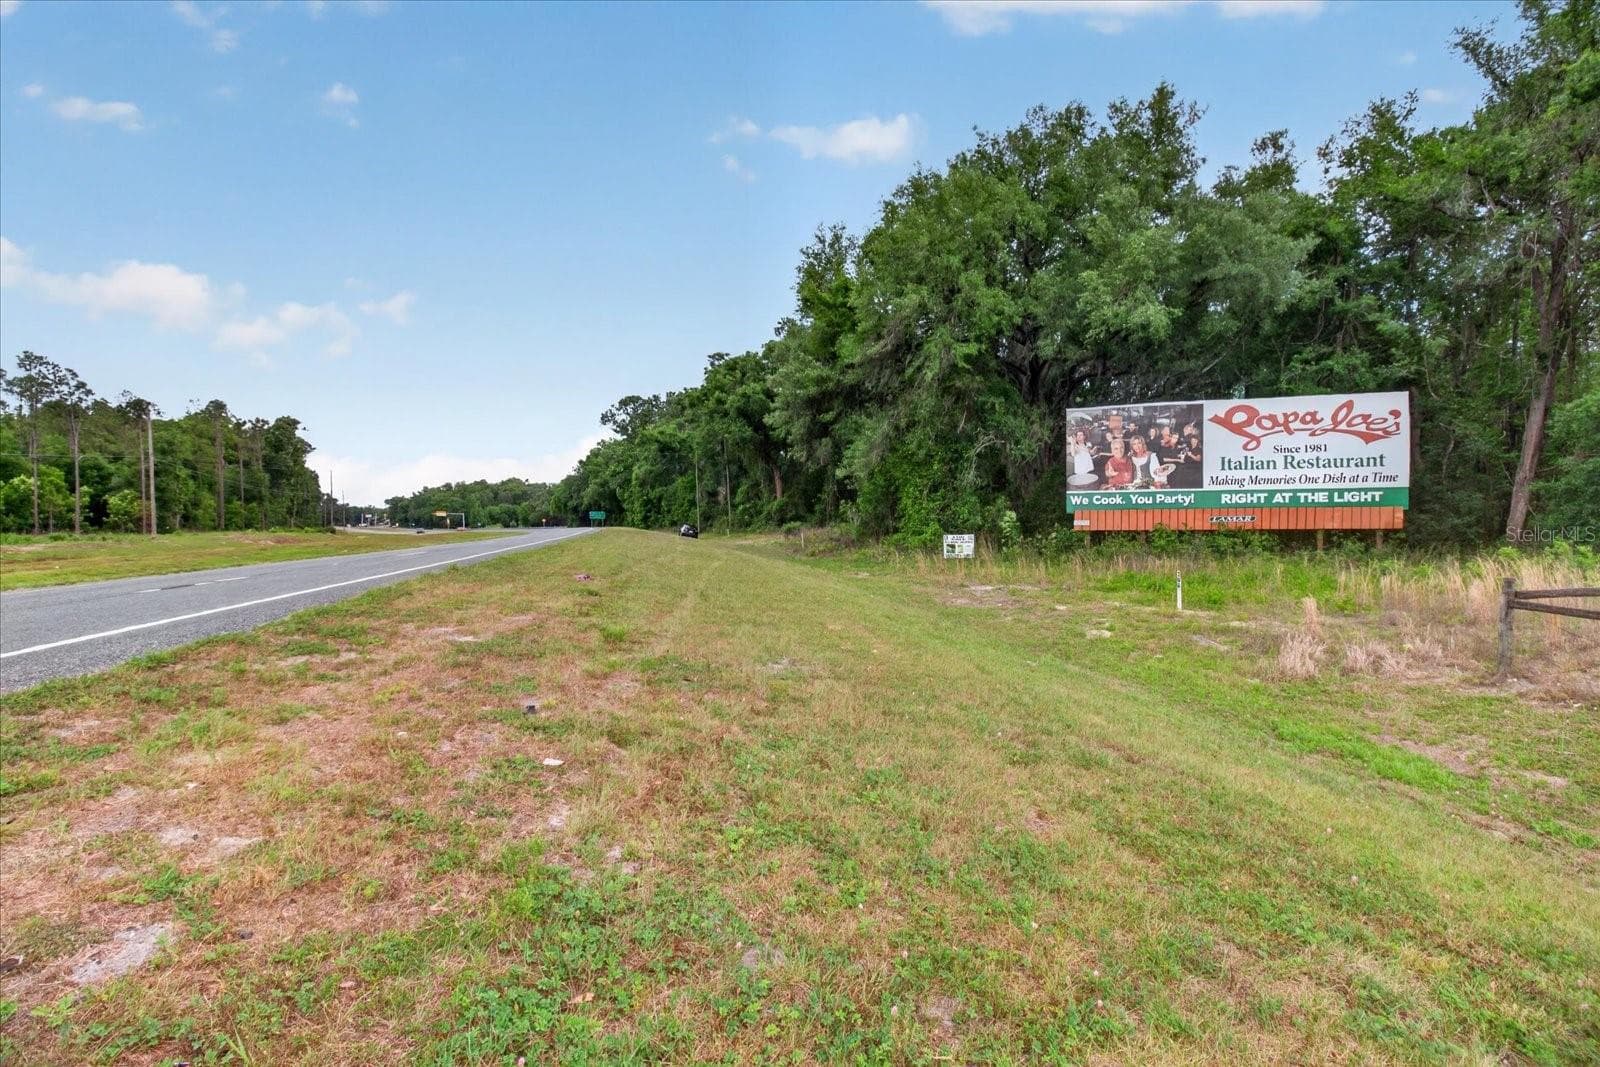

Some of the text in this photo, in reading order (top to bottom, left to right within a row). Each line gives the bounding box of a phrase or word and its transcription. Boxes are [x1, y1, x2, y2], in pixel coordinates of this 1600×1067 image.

[1208, 399, 1401, 451] Papa Joe's
[1273, 443, 1328, 453] Since 1981
[1220, 453, 1386, 471] Italian Restaurant
[1208, 471, 1399, 488] Making Memories One Dish at a Time
[1069, 495, 1089, 506] We
[1128, 494, 1154, 505] You
[1156, 493, 1195, 506] Party!
[1221, 491, 1383, 504] RIGHT AT THE LIGHT
[1211, 515, 1252, 523] LAMAR
